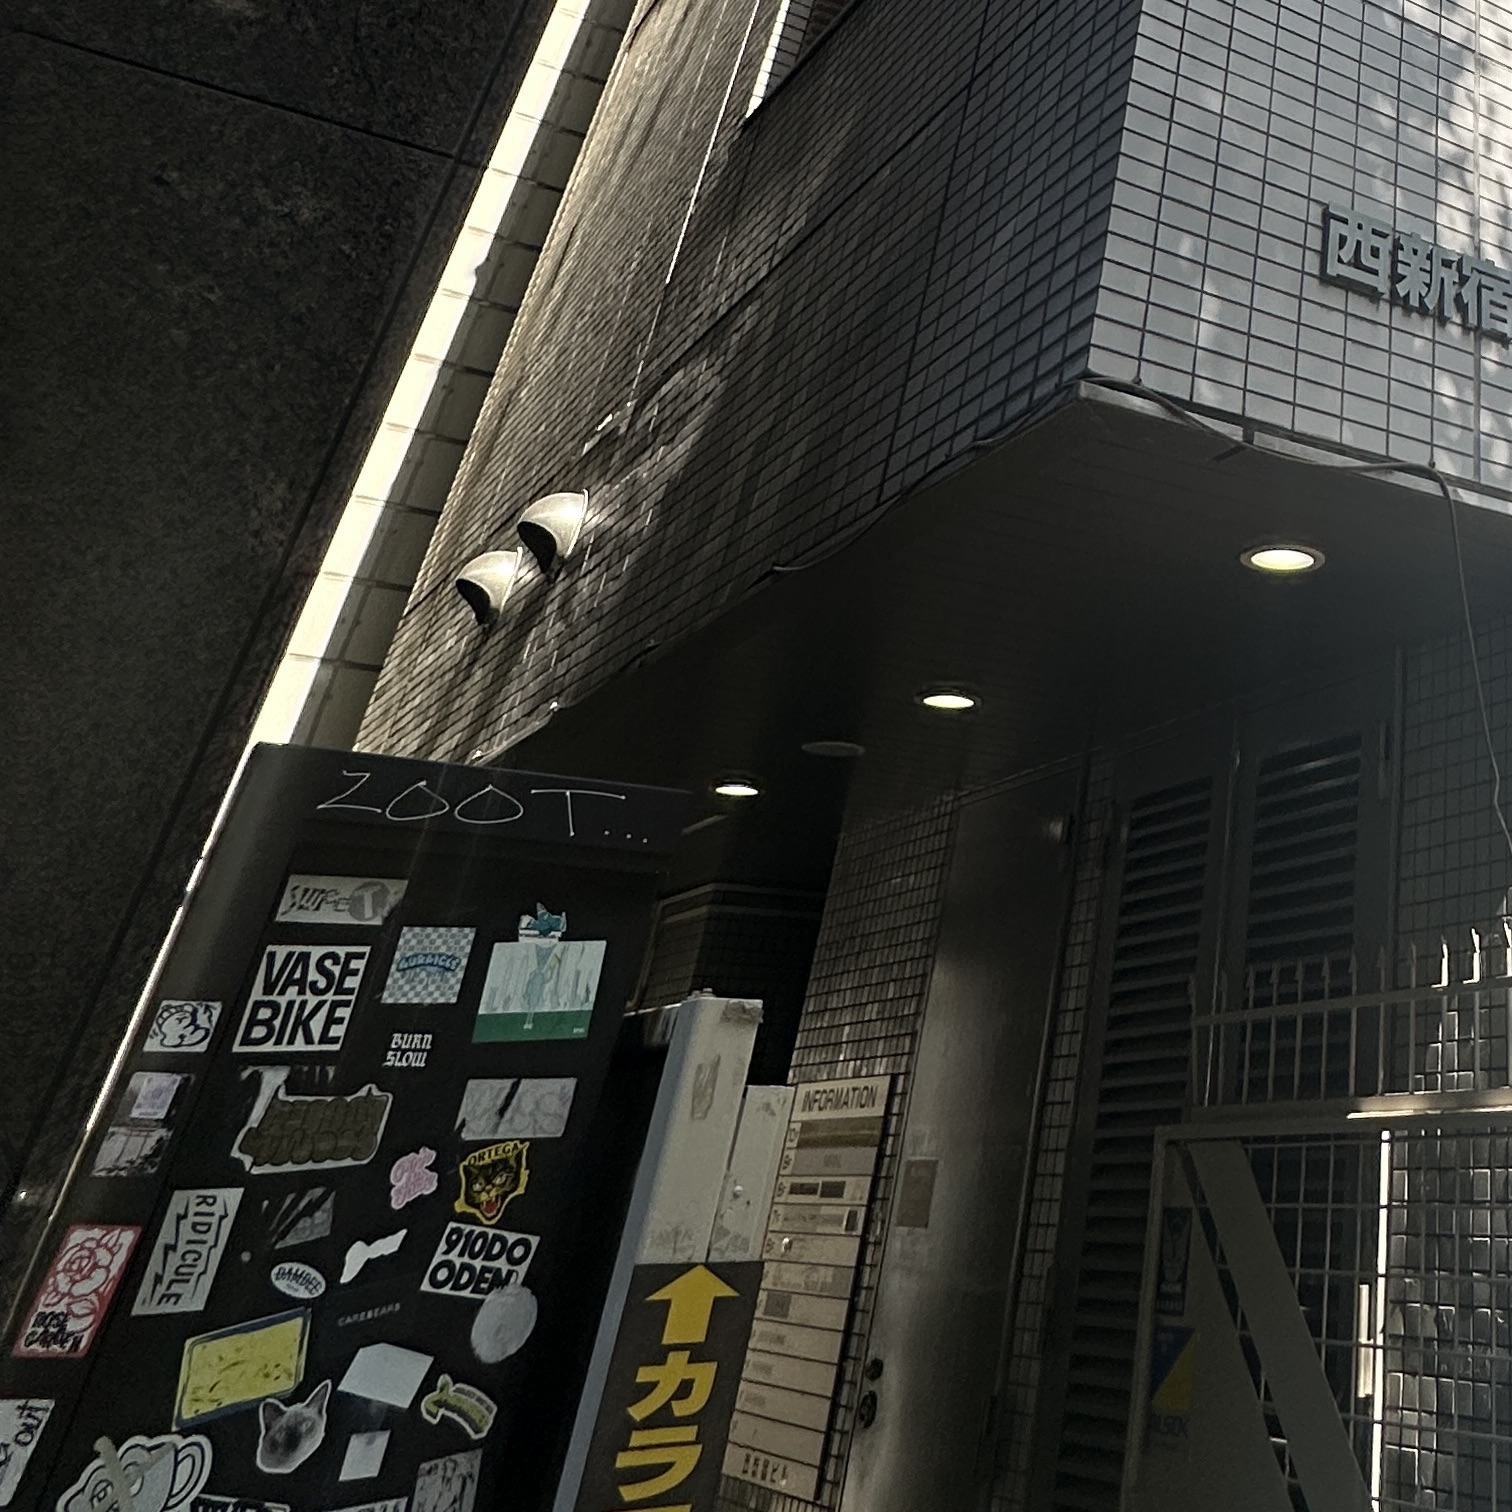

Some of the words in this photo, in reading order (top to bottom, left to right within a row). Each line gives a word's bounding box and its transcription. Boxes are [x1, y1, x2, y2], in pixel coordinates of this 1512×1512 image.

[258, 950, 368, 997] VASE
[240, 998, 347, 1047] BIKE
[390, 1032, 433, 1050] BURN
[383, 1051, 428, 1068] SLOW
[801, 1085, 878, 1113] INFORMATION
[467, 1142, 519, 1166] ORTEGA
[157, 1194, 218, 1308] RIDICULE
[444, 1226, 533, 1267] 910DO
[612, 1350, 718, 1512] カラ
